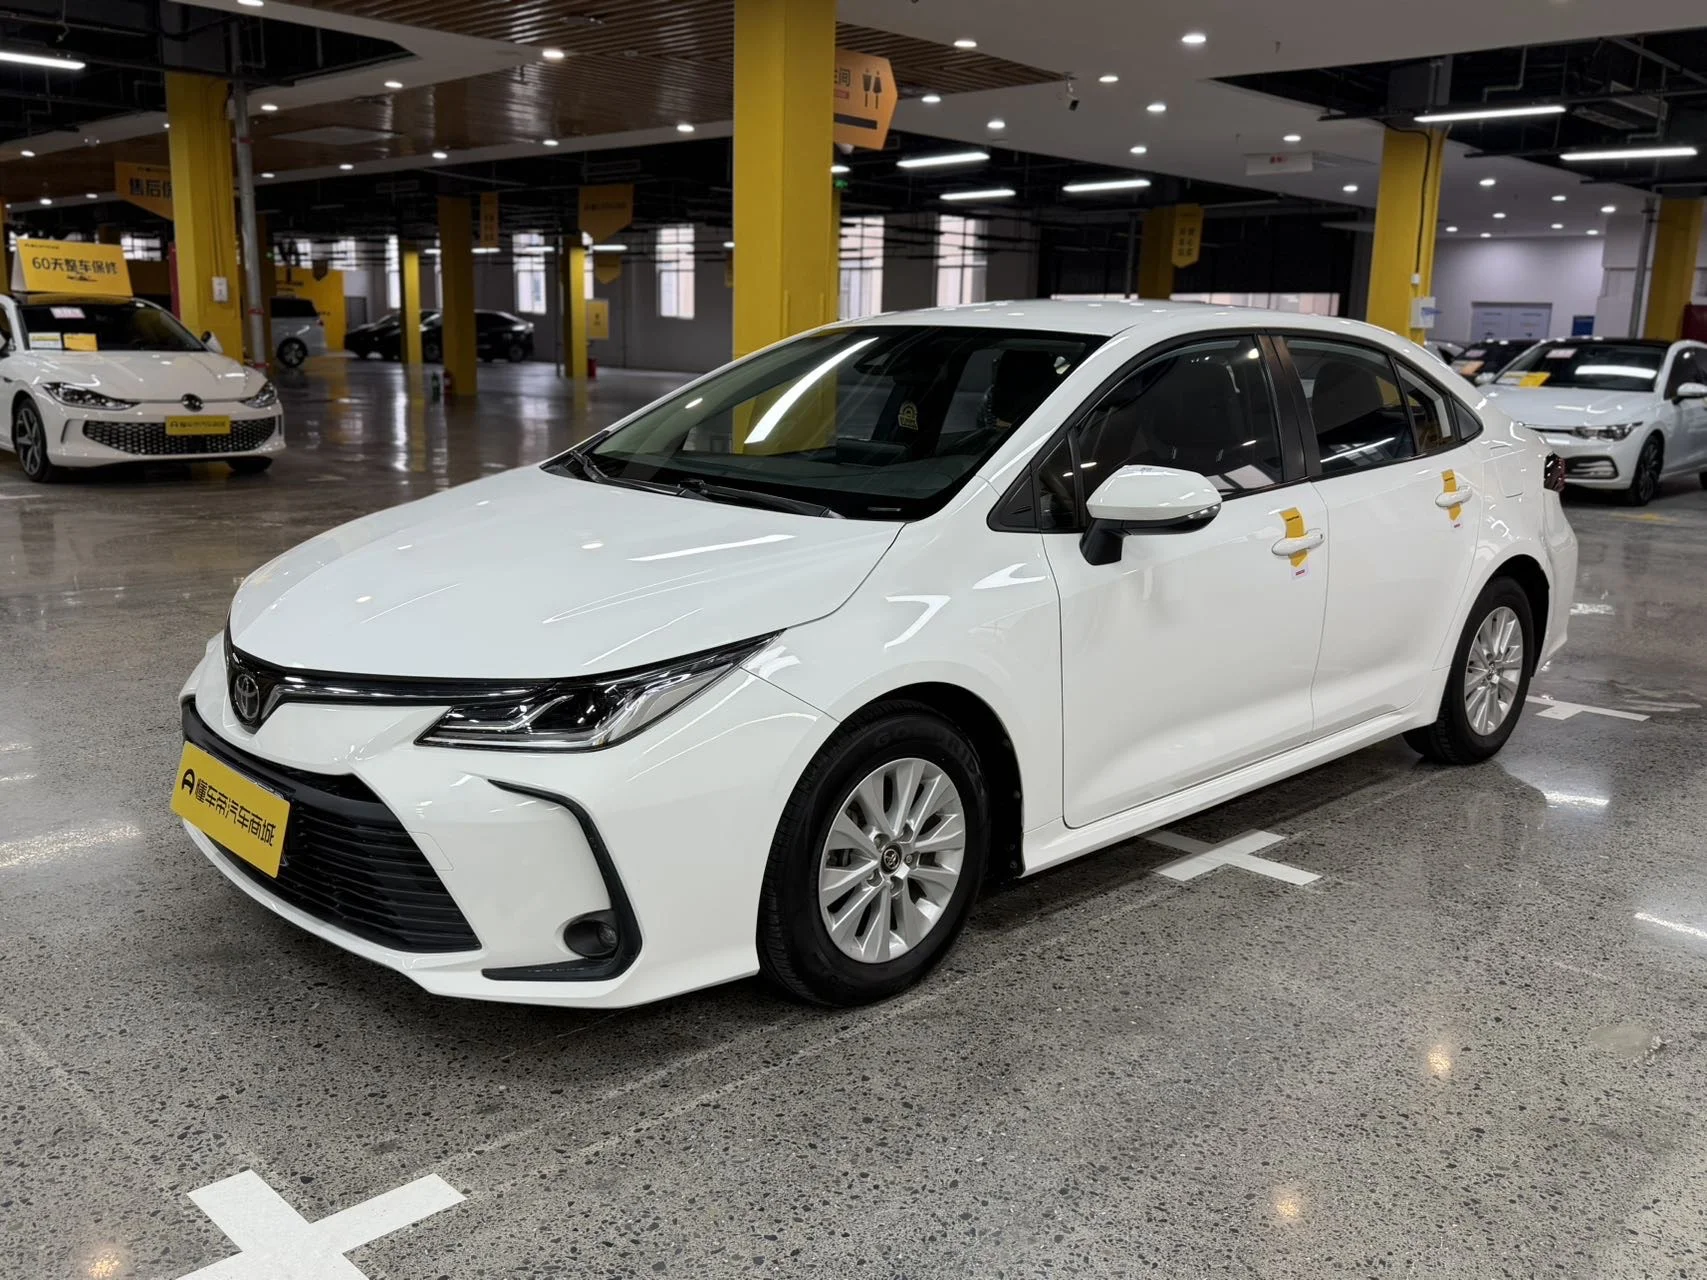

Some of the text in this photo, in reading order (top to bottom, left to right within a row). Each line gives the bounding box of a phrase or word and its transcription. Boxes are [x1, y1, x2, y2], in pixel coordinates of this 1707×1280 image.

[32, 257, 118, 275] 60天整车保修
[195, 778, 276, 846] 懂车帝汽车商城
